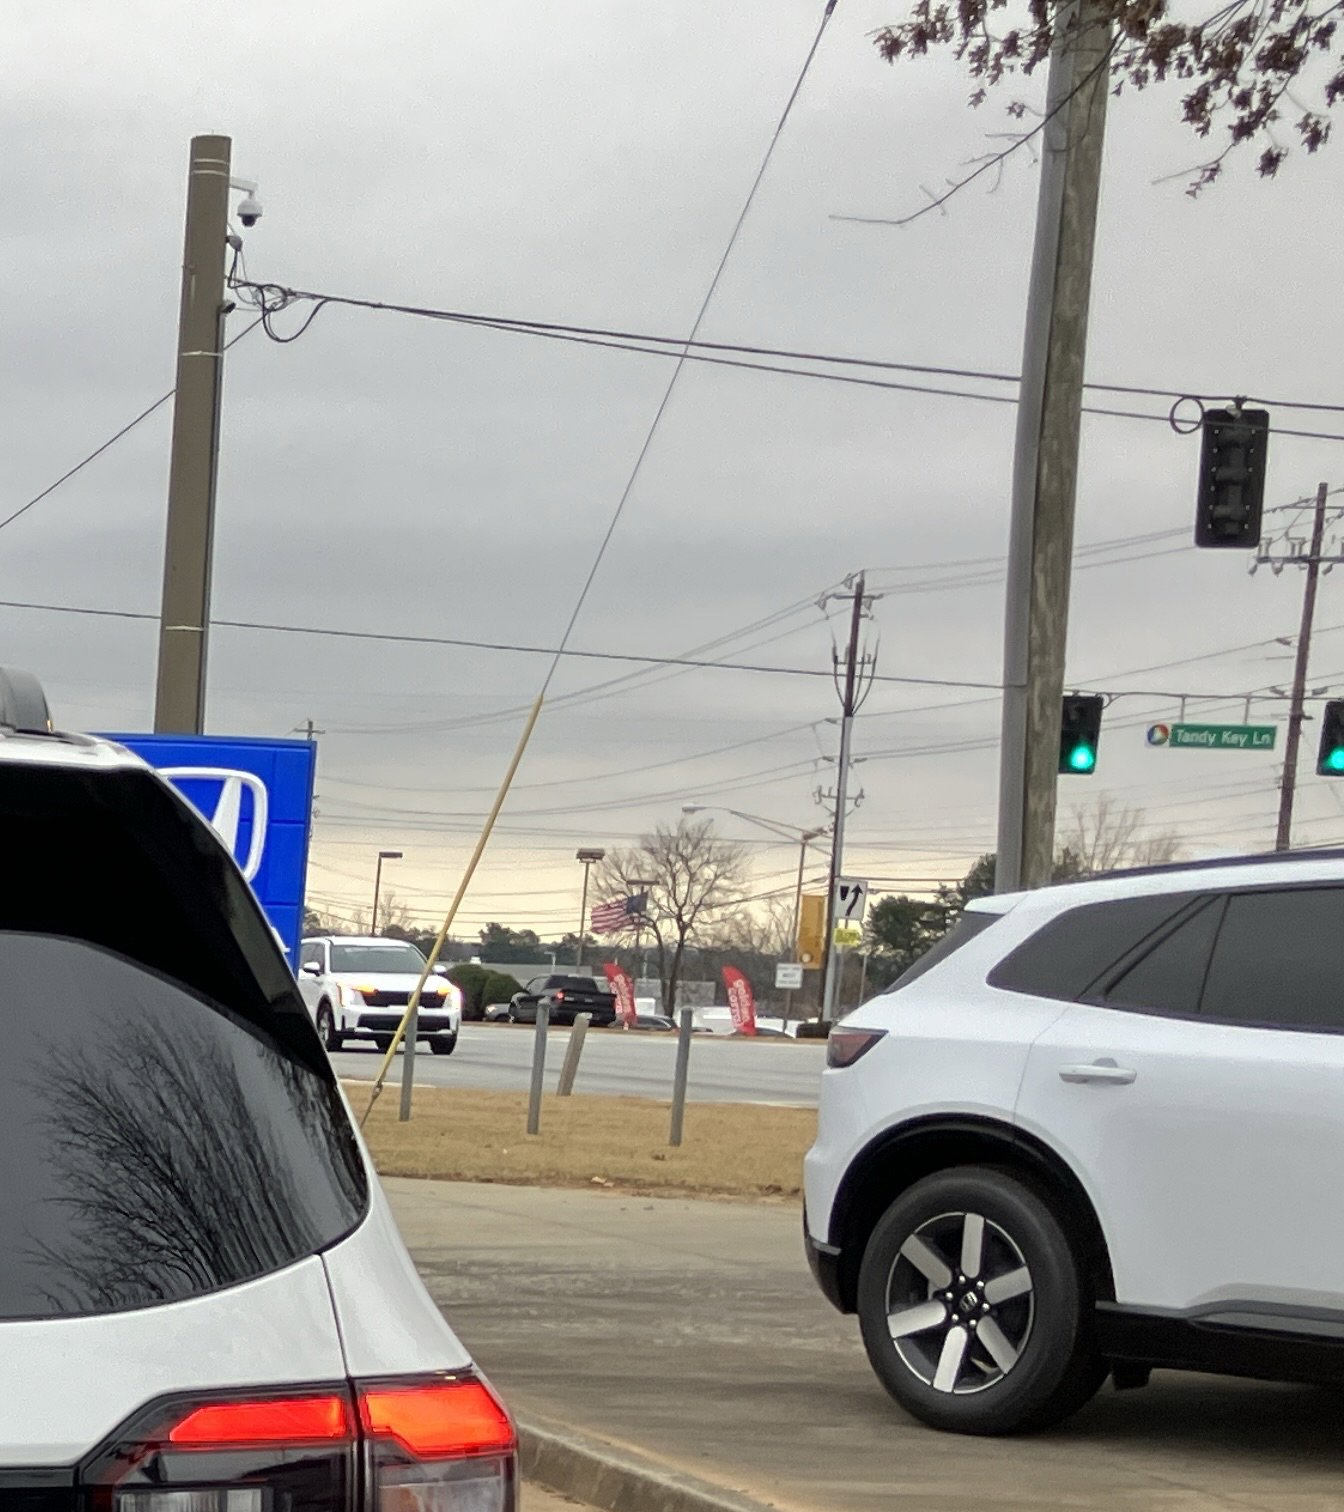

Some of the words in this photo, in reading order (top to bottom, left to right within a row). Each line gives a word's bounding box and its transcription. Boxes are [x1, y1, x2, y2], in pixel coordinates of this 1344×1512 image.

[1176, 729, 1216, 747] Tandy
[1221, 731, 1248, 747] Key
[1253, 732, 1272, 745] Ln
